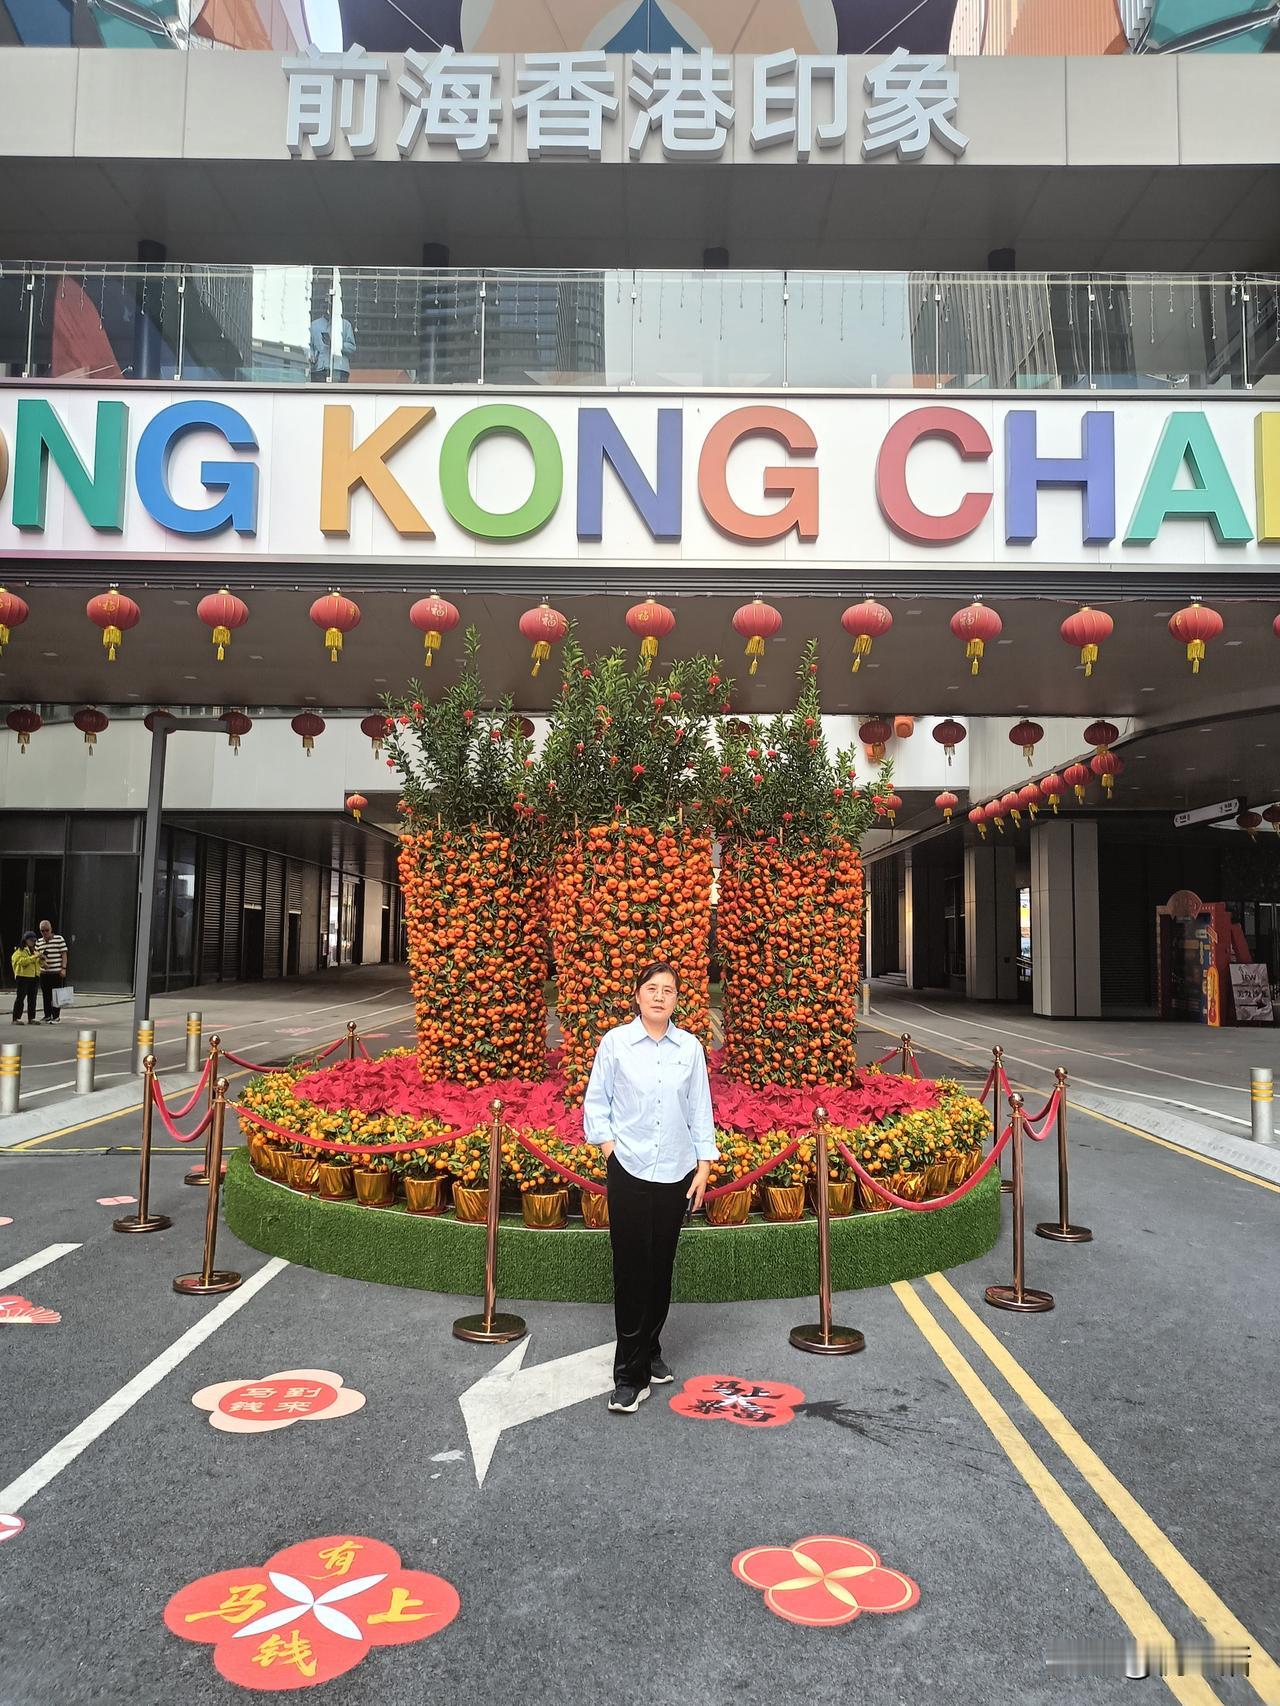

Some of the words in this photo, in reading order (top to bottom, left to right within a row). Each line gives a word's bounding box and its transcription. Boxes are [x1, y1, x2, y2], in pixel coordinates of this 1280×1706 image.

[281, 43, 970, 162] 前海香港印象
[0, 399, 260, 538] NG
[320, 404, 819, 546] KONG
[876, 406, 1280, 546] CHA
[239, 1387, 323, 1399] 马到
[304, 1540, 364, 1581] 有
[184, 1583, 268, 1624] 马
[366, 1587, 442, 1625] 上
[251, 1629, 318, 1677] 钱
